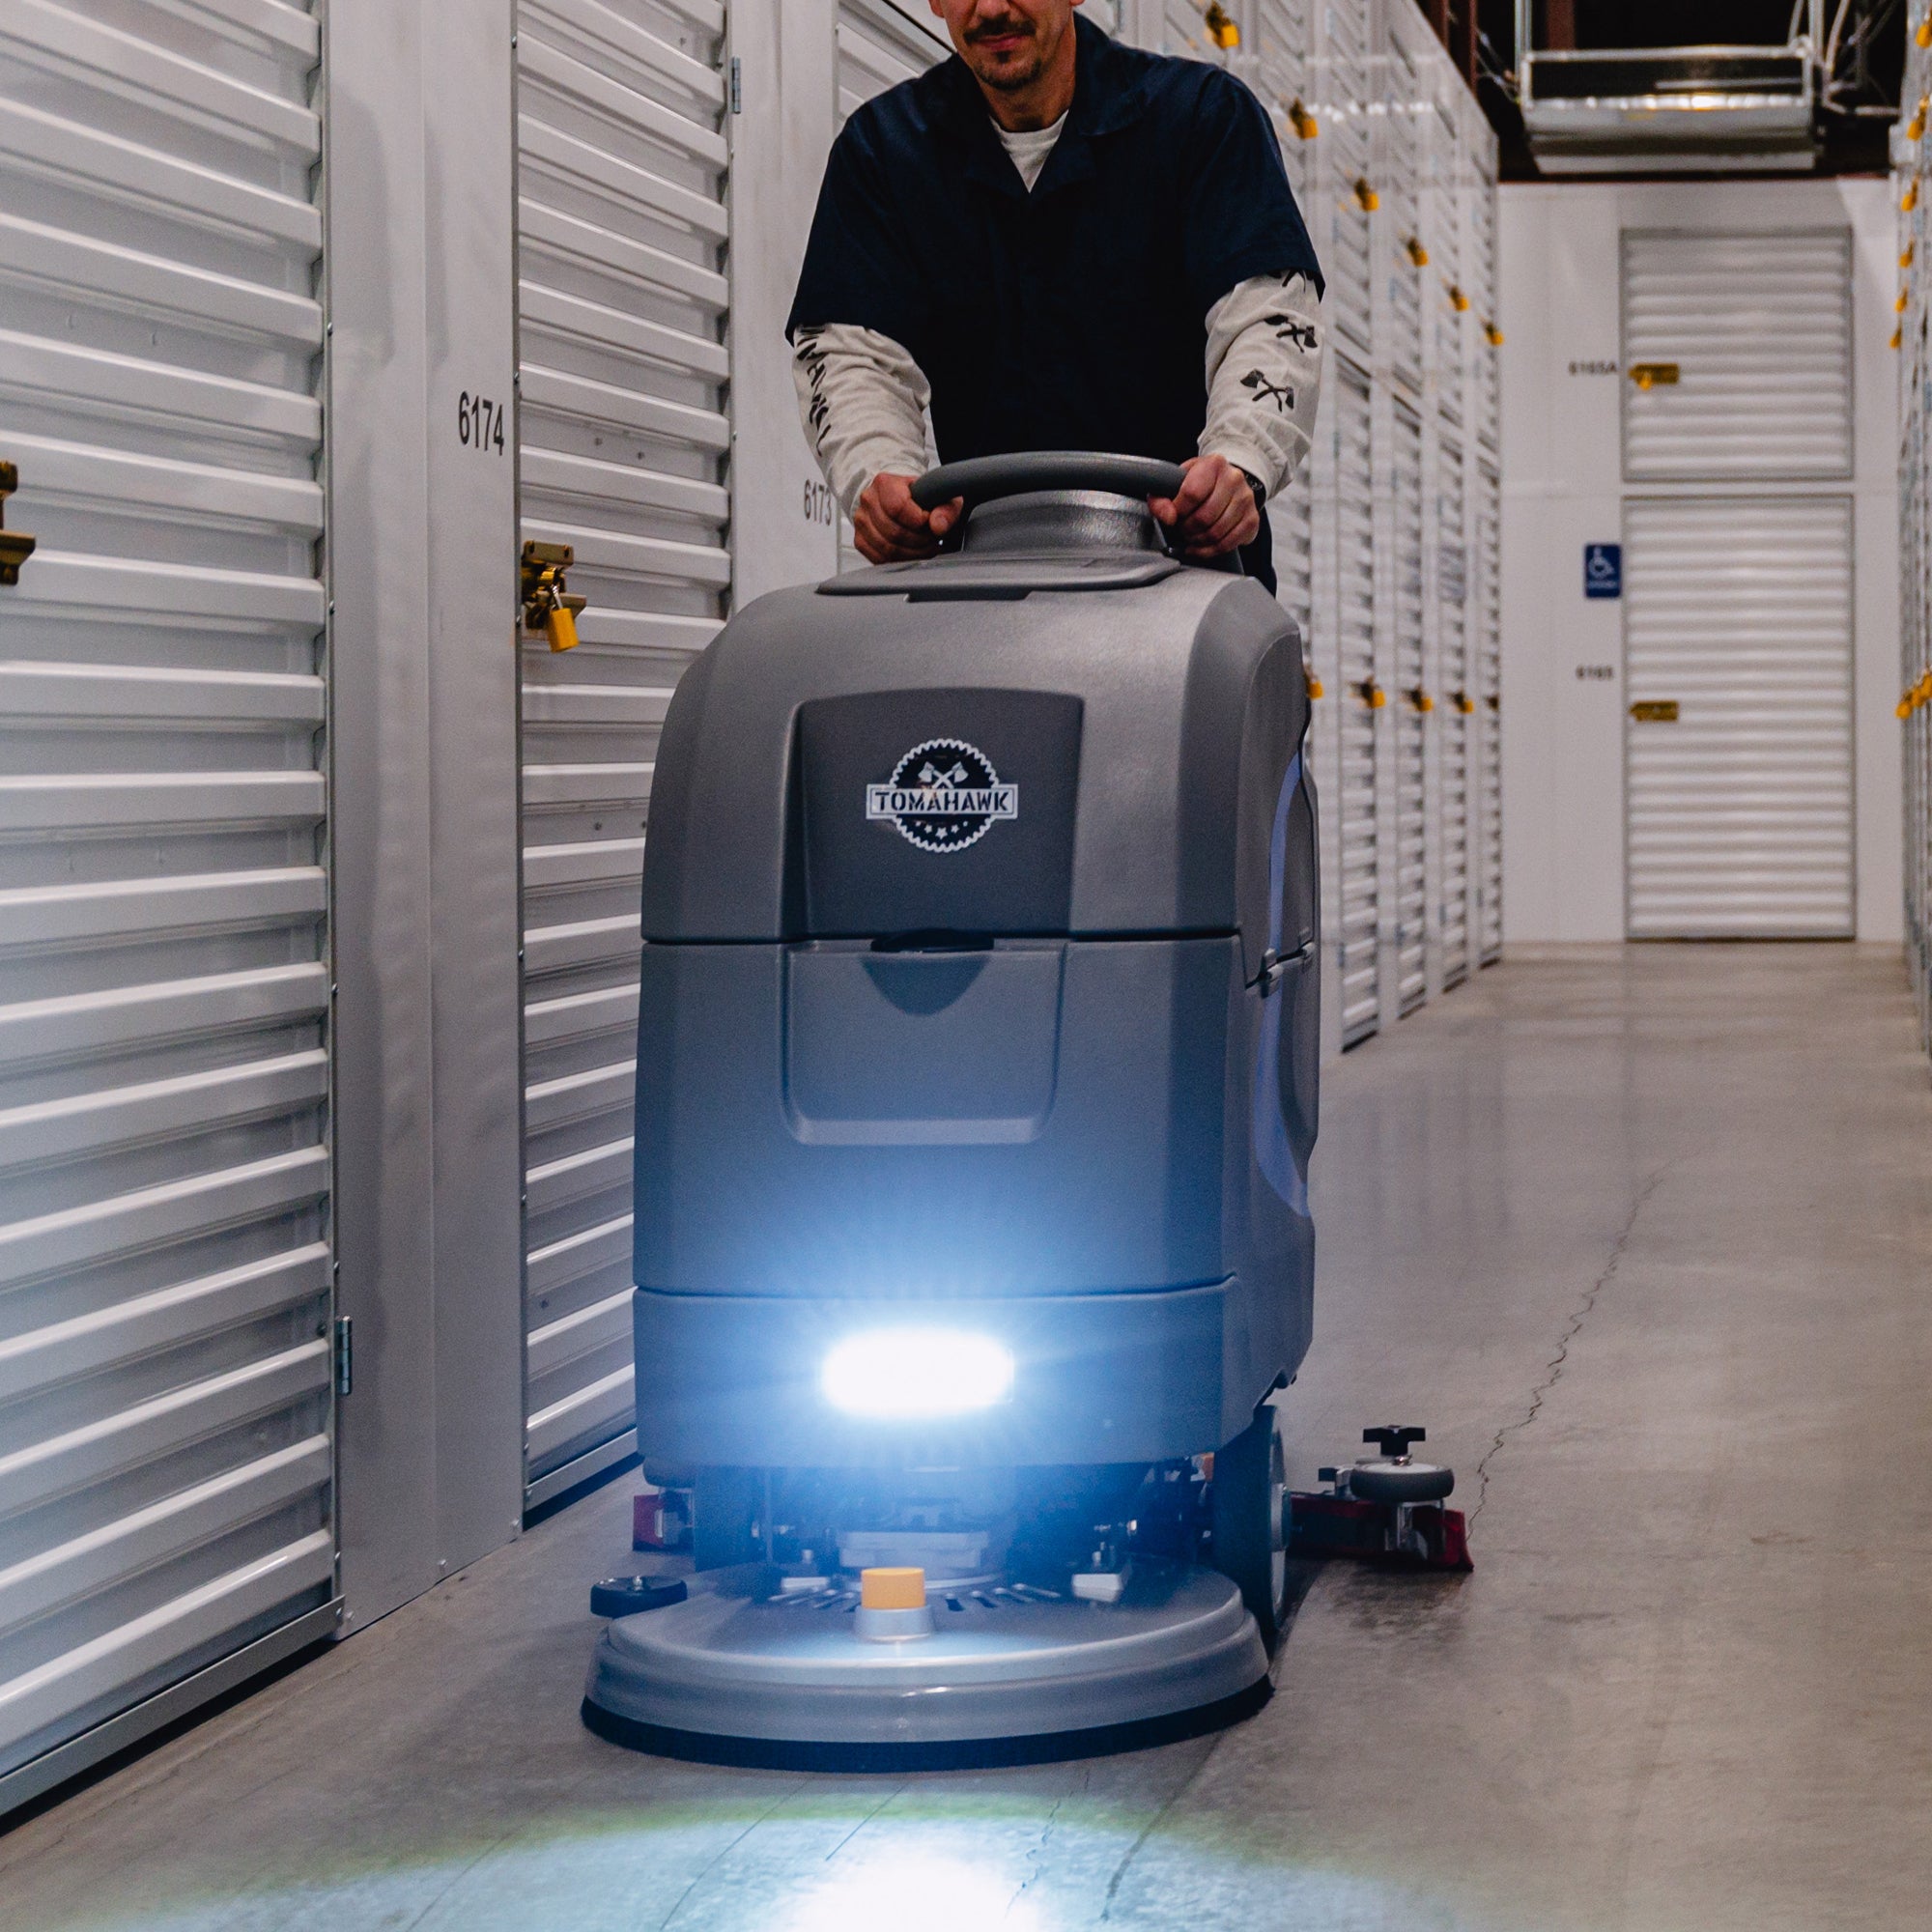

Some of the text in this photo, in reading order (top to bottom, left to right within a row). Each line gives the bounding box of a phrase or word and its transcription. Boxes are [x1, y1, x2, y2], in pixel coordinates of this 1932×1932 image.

[459, 390, 504, 456] 6174
[804, 478, 832, 526] 6173
[874, 791, 1009, 811] TOMAHAWK
